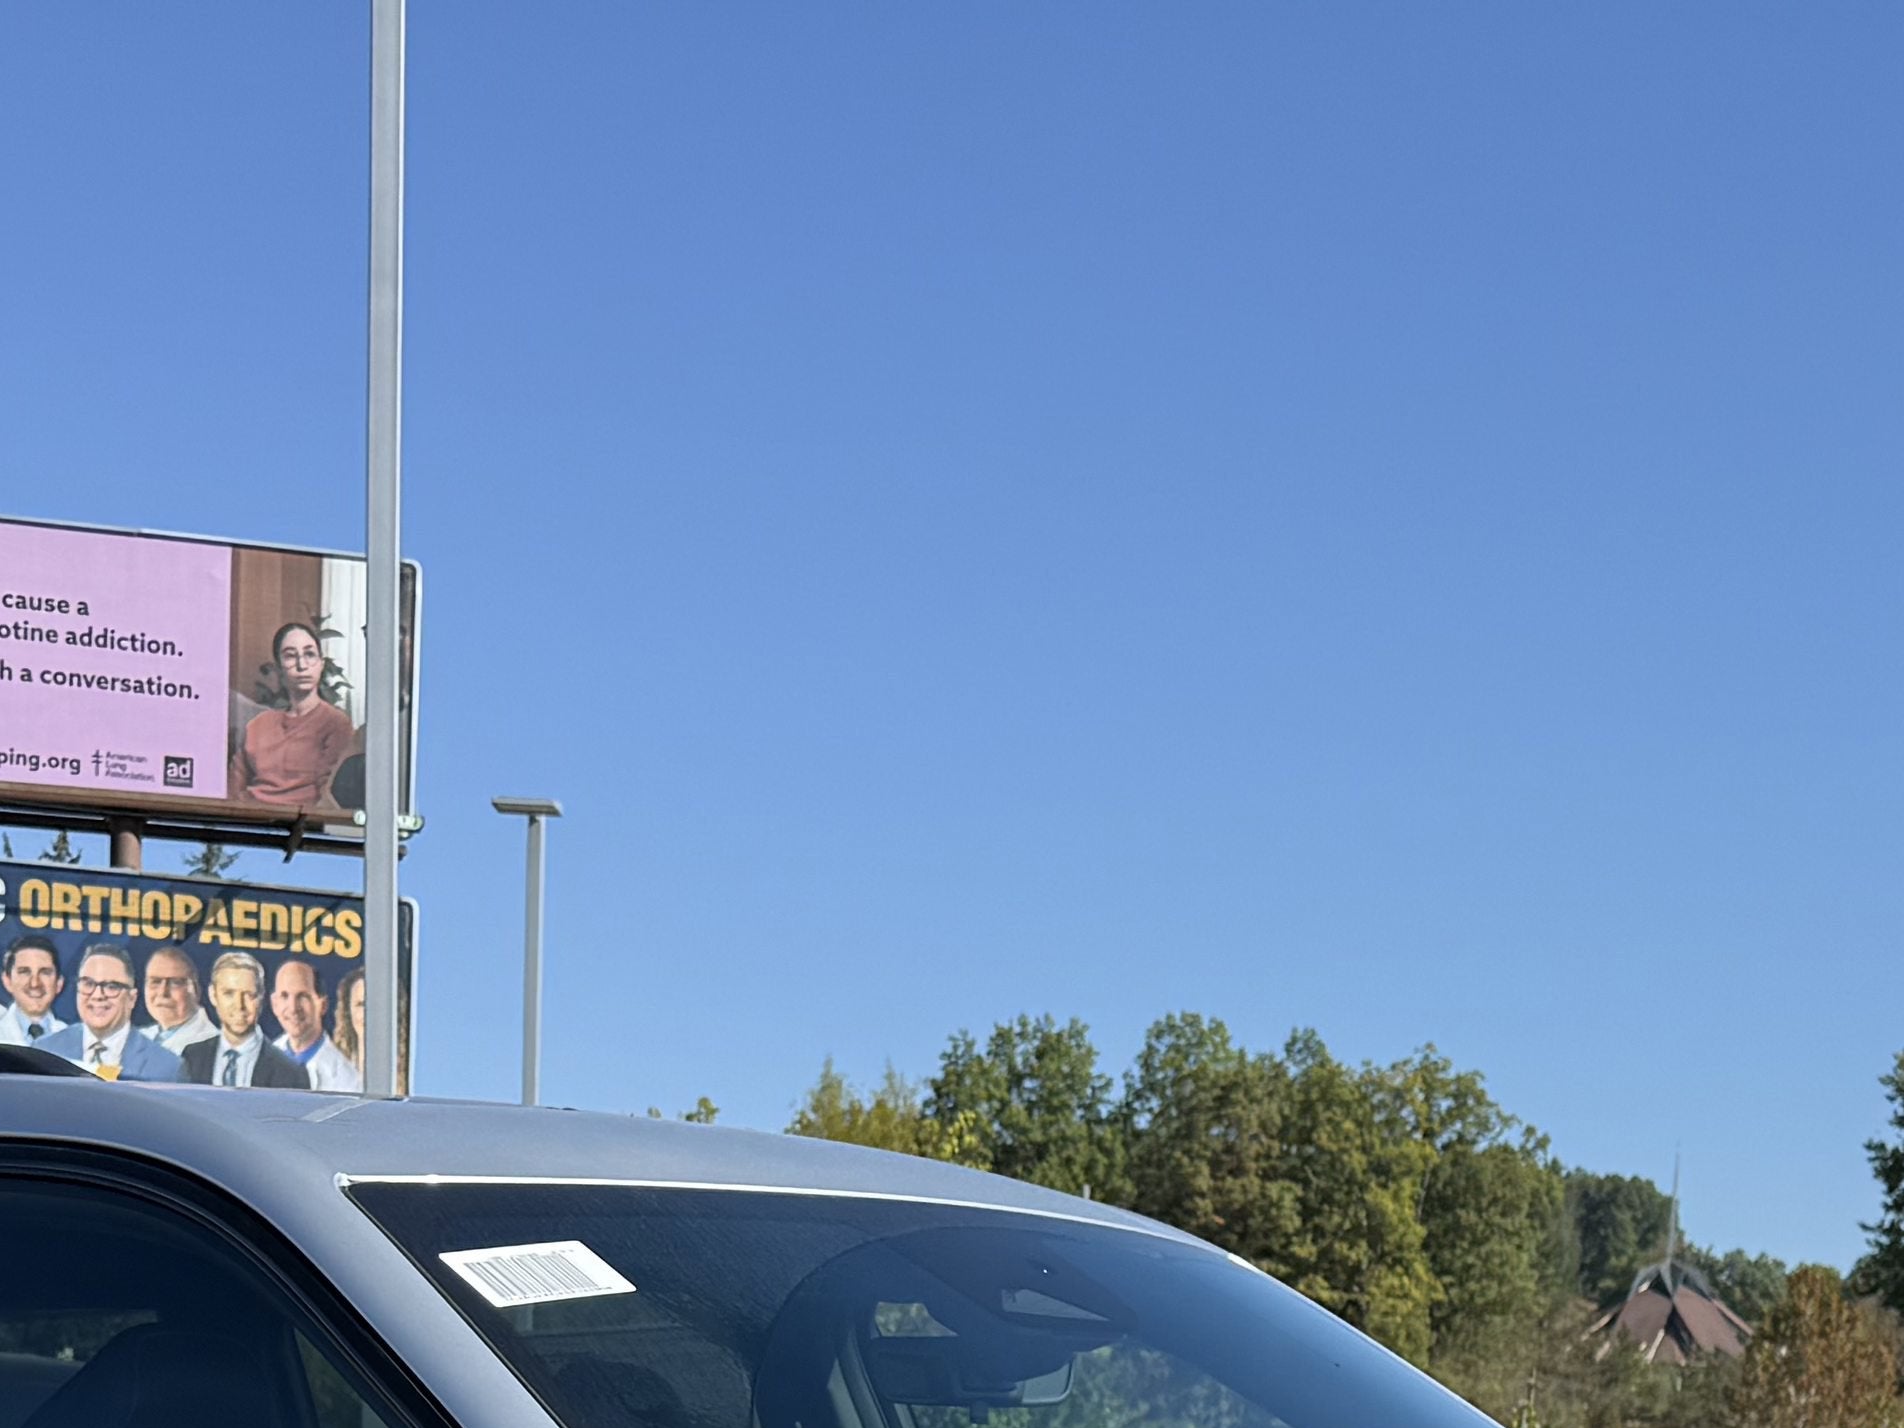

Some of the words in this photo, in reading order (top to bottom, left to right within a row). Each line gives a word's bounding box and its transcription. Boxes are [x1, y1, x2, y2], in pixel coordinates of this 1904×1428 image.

[2, 591, 70, 615] cause
[77, 600, 89, 616] a
[65, 627, 184, 657] addiction.
[20, 667, 33, 683] a
[39, 669, 200, 700] conversation.
[166, 759, 192, 779] ad
[19, 878, 363, 958] ORTHOPAEDICS
